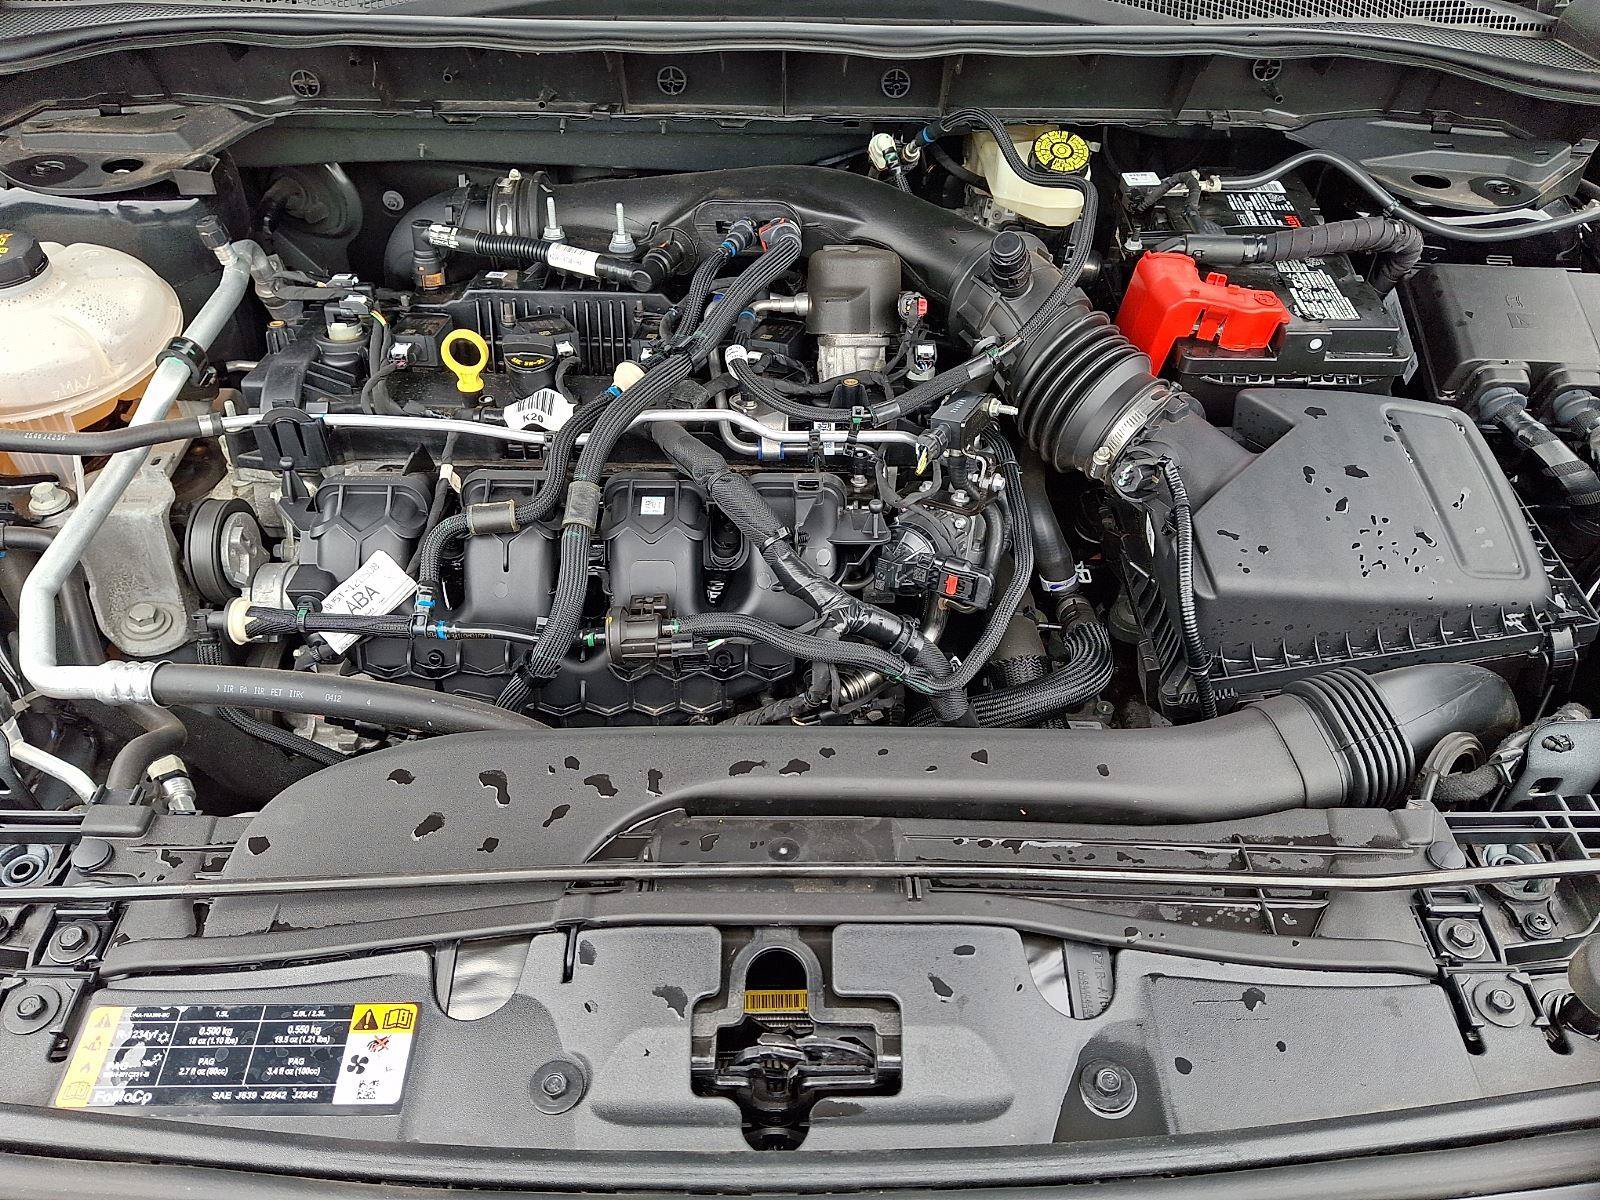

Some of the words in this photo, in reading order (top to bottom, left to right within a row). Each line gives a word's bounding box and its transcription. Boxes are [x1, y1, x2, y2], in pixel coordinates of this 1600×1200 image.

[523, 412, 544, 423] K20
[345, 585, 381, 616] ABA
[270, 688, 282, 697] PET
[325, 693, 342, 702] 0412
[198, 1027, 221, 1036] 0.500
[221, 1027, 234, 1037] kg
[287, 1026, 310, 1035] 0.550
[310, 1026, 322, 1036] kg
[198, 1057, 215, 1066] PAG
[287, 1057, 305, 1066] PAG
[178, 1067, 190, 1076] 2.7
[212, 1091, 233, 1100] SAE
[235, 1091, 257, 1100] J639
[261, 1091, 287, 1100] J2842
[292, 1090, 318, 1099] J2845
